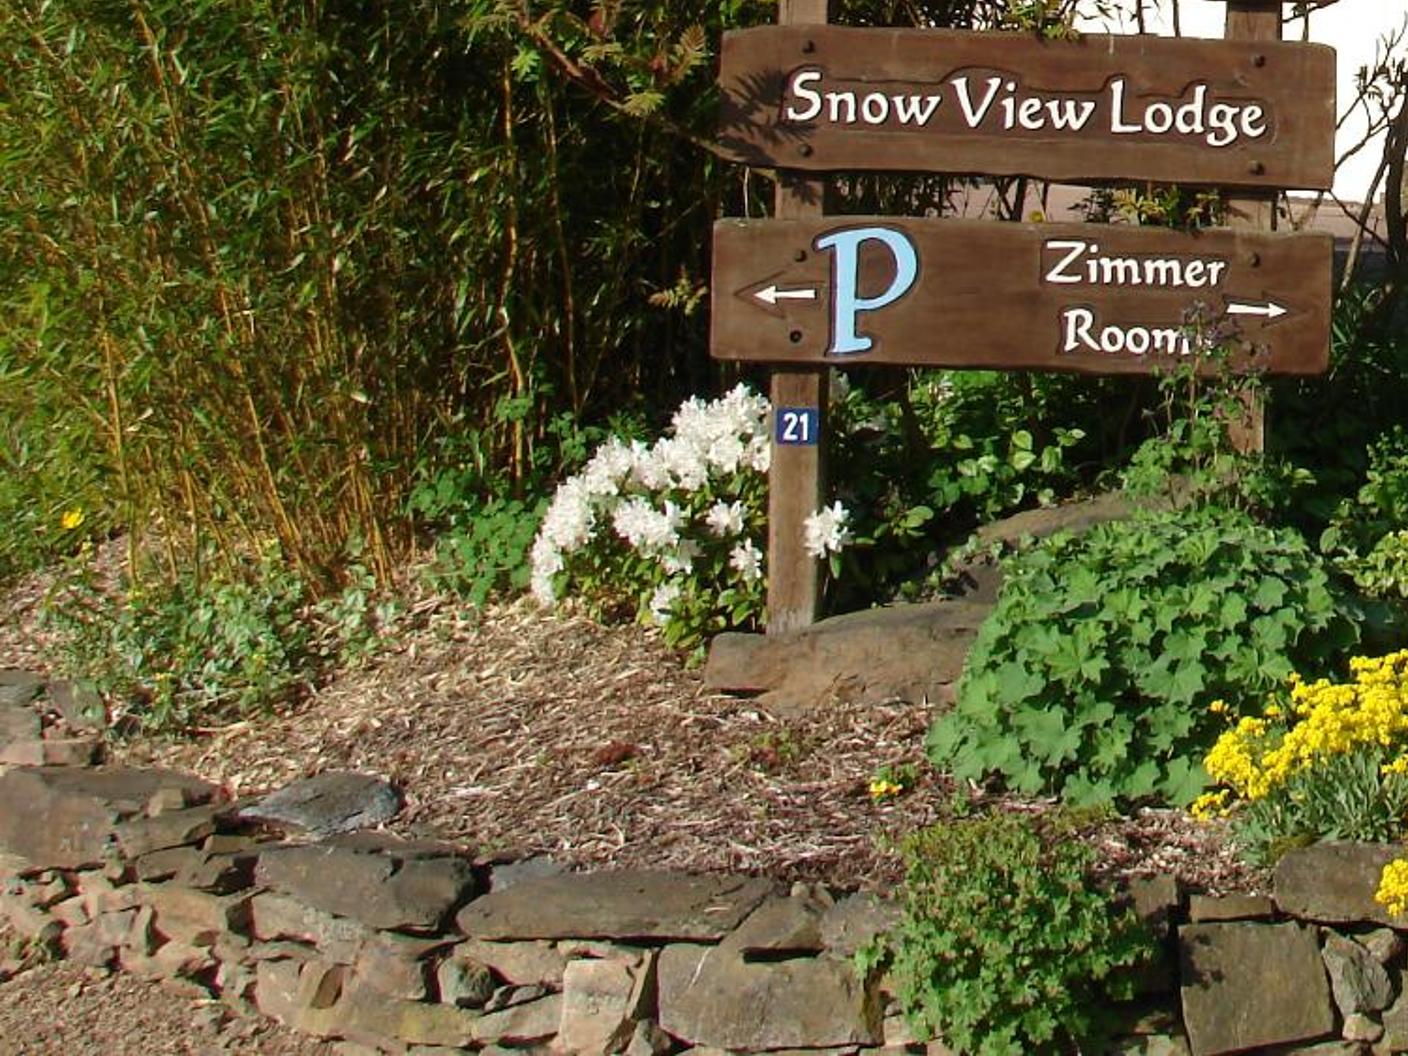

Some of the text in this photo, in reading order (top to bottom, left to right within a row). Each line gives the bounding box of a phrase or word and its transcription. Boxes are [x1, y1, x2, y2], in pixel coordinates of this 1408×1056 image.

[787, 72, 1267, 147] Snow View Lodge
[1045, 240, 1226, 288] Zimmer
[815, 226, 919, 354] P
[1063, 308, 1214, 355] Room
[783, 412, 808, 441] 21
